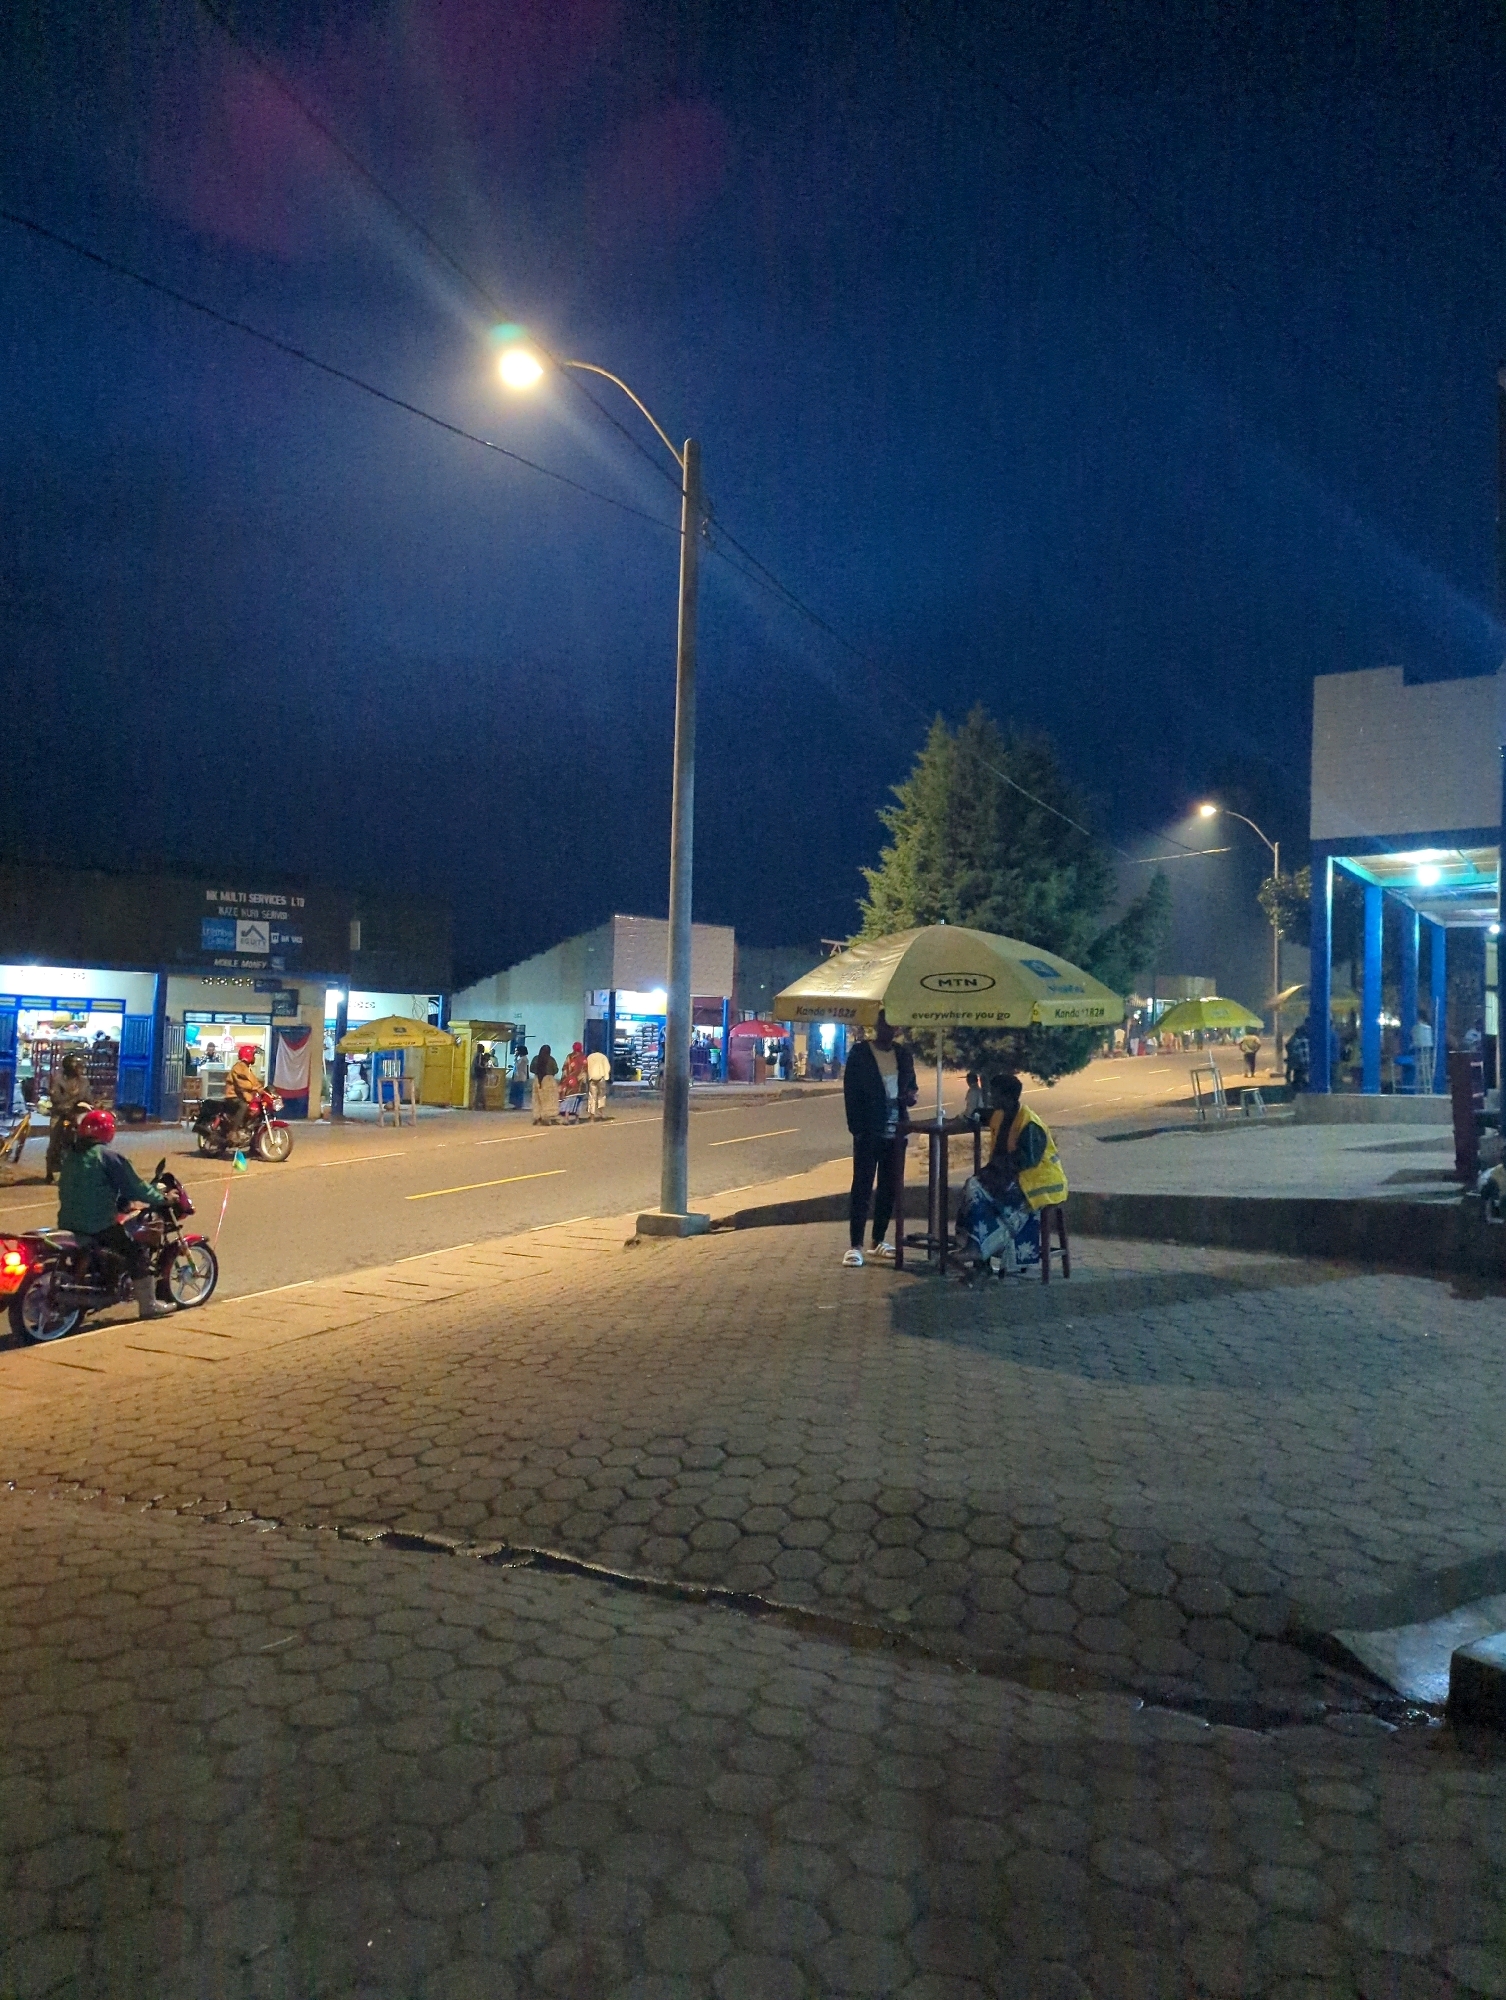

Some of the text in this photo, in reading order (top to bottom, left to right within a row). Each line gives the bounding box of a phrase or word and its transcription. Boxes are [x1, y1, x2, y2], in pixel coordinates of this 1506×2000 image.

[220, 891, 247, 902] MULTI
[248, 893, 287, 905] SERVICES
[291, 896, 305, 908] LTD
[240, 938, 266, 947] EQUITY
[240, 960, 267, 970] MONEY
[938, 978, 978, 988] MTN
[796, 1005, 826, 1016] Kanda
[911, 1010, 1011, 1021] everywhere you go
[1055, 1007, 1080, 1018] Kanda
